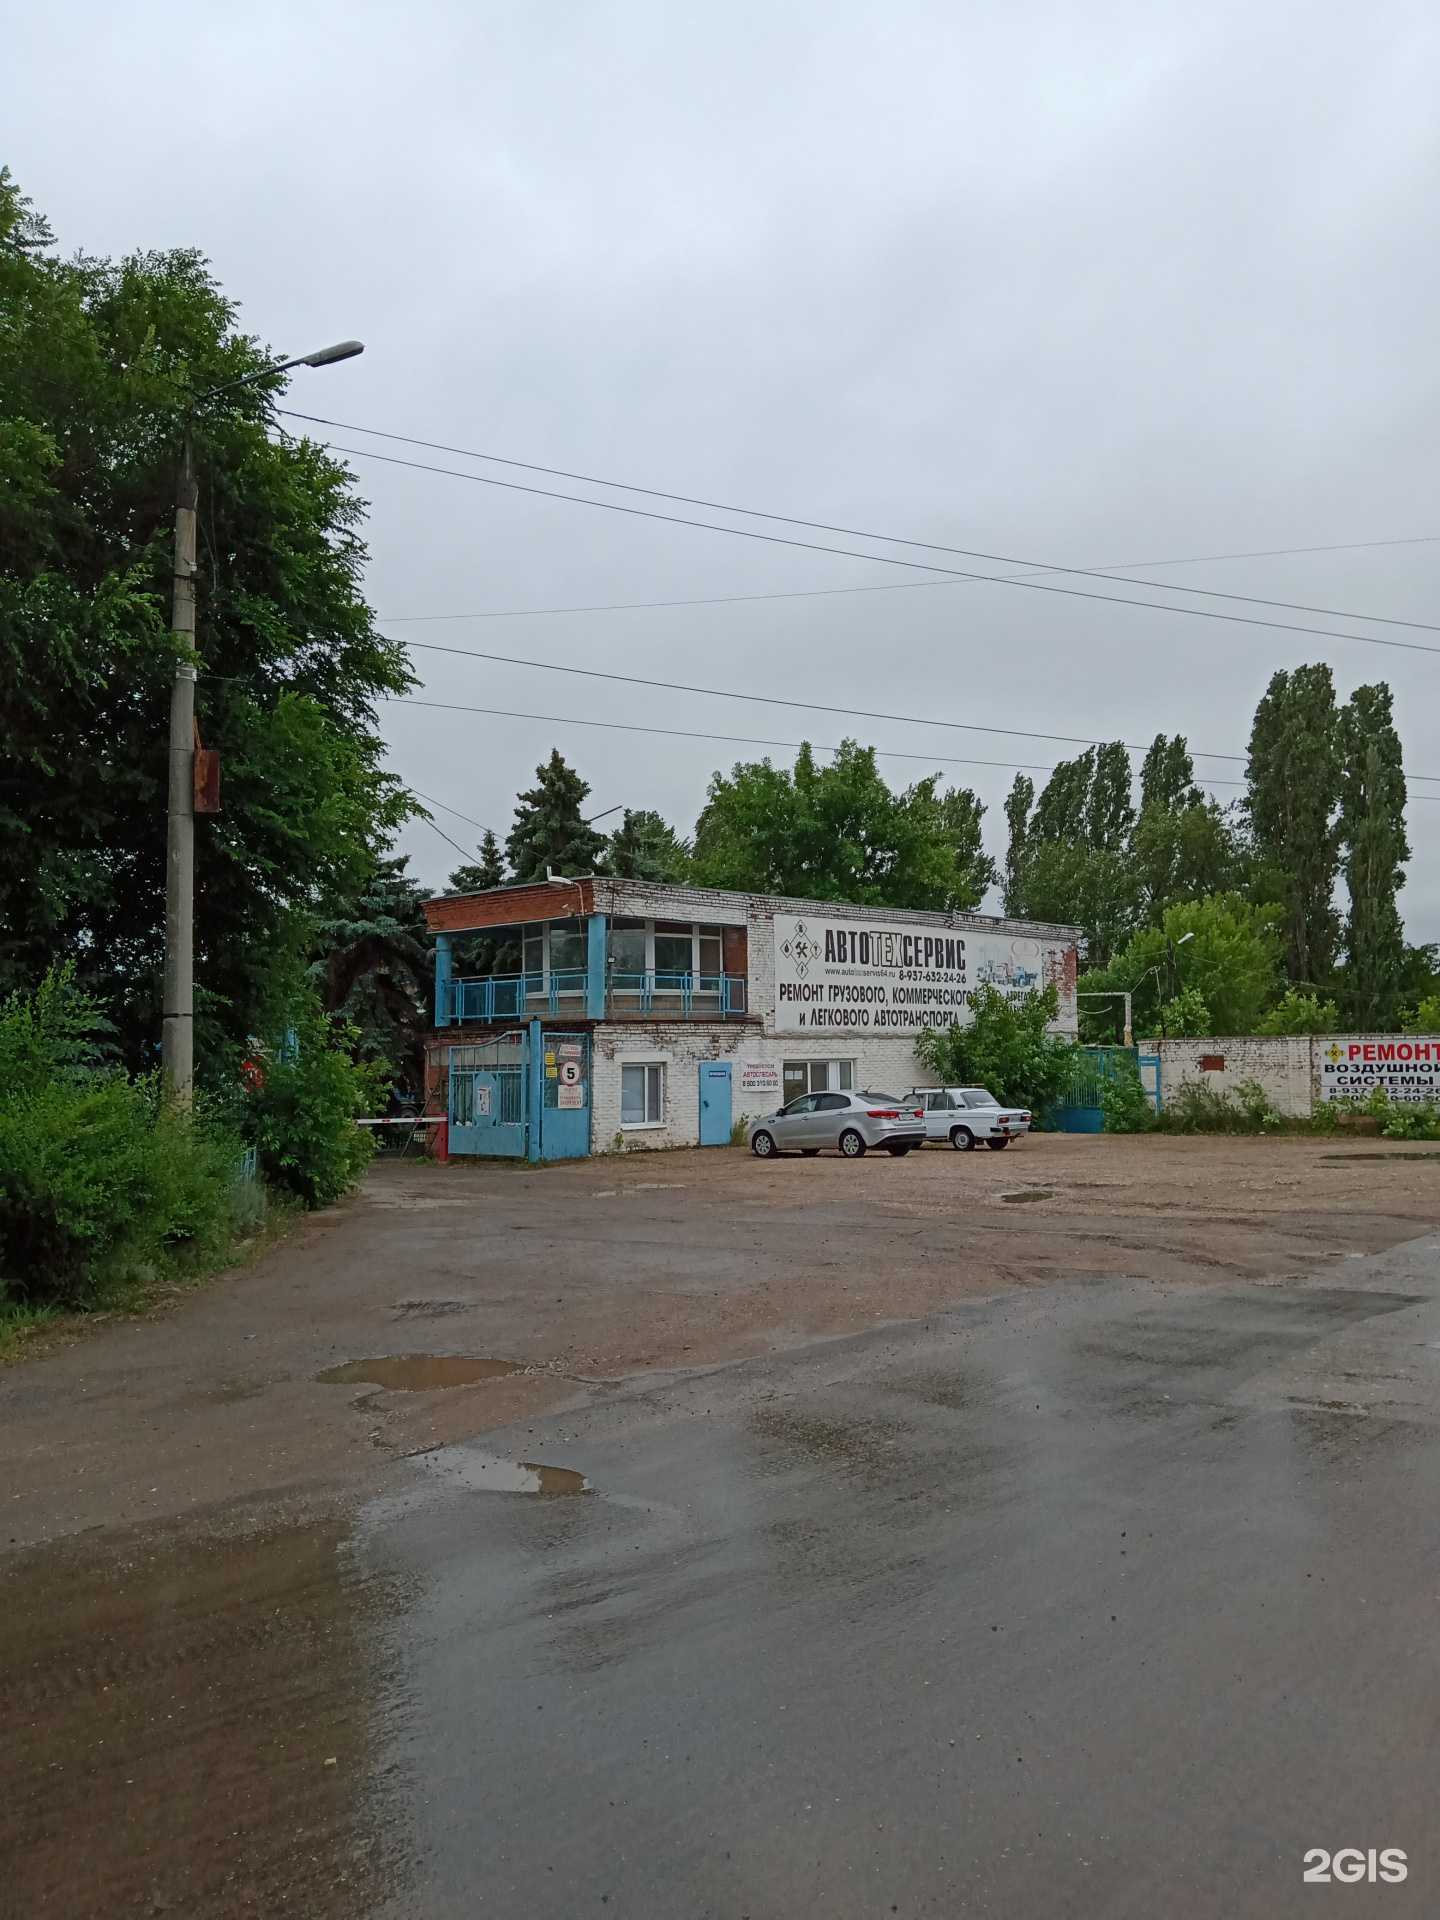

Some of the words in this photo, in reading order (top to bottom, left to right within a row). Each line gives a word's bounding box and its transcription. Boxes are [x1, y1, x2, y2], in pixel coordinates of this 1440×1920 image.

[824, 929, 966, 971] АВТОТЕХСЕРВИС
[898, 970, 967, 984] 8-937-632-24-26
[779, 983, 824, 1002] РЕМОНТ
[828, 984, 889, 1007] ГРУЗОВОГО,
[810, 1008, 870, 1026] ЛЕГКОВОГО
[873, 1009, 959, 1028] АВТОТРАНСПОРТА
[567, 1068, 575, 1080] 5
[1337, 1076, 1434, 1085] СИСТЕМЫ
